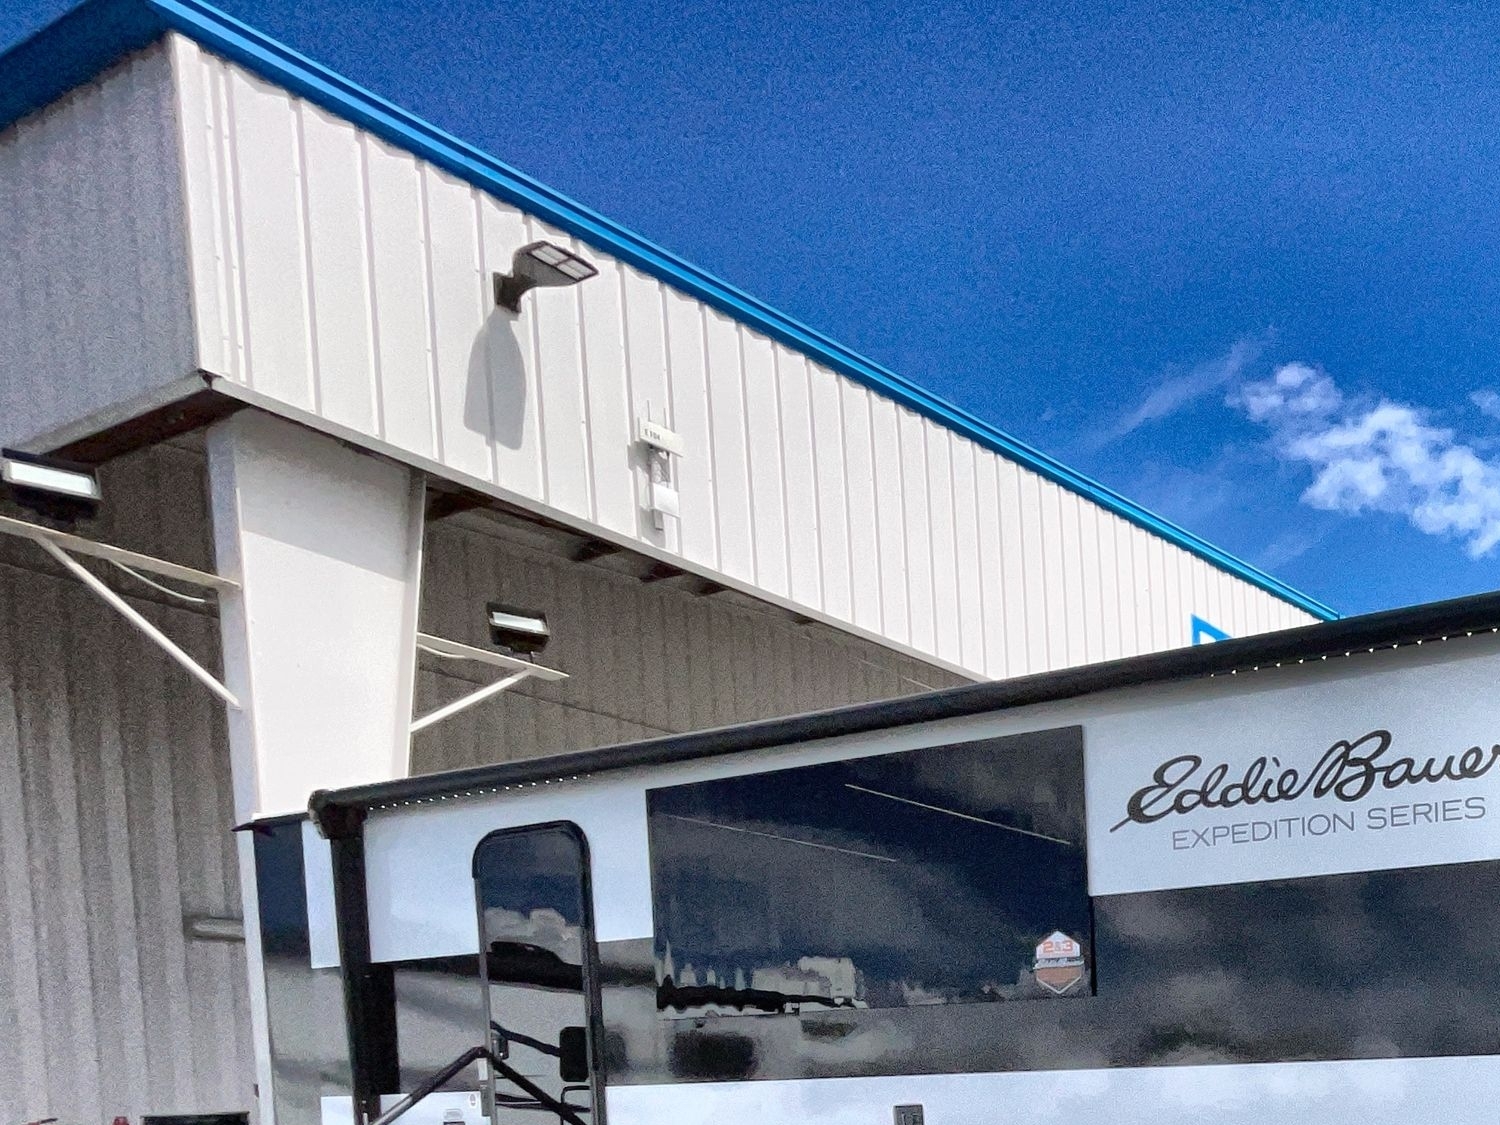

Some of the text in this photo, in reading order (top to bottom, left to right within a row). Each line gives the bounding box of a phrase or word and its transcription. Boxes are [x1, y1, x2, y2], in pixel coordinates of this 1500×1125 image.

[1110, 755, 1312, 832] Eddie
[1172, 797, 1486, 850] EXPEDITION SERIES
